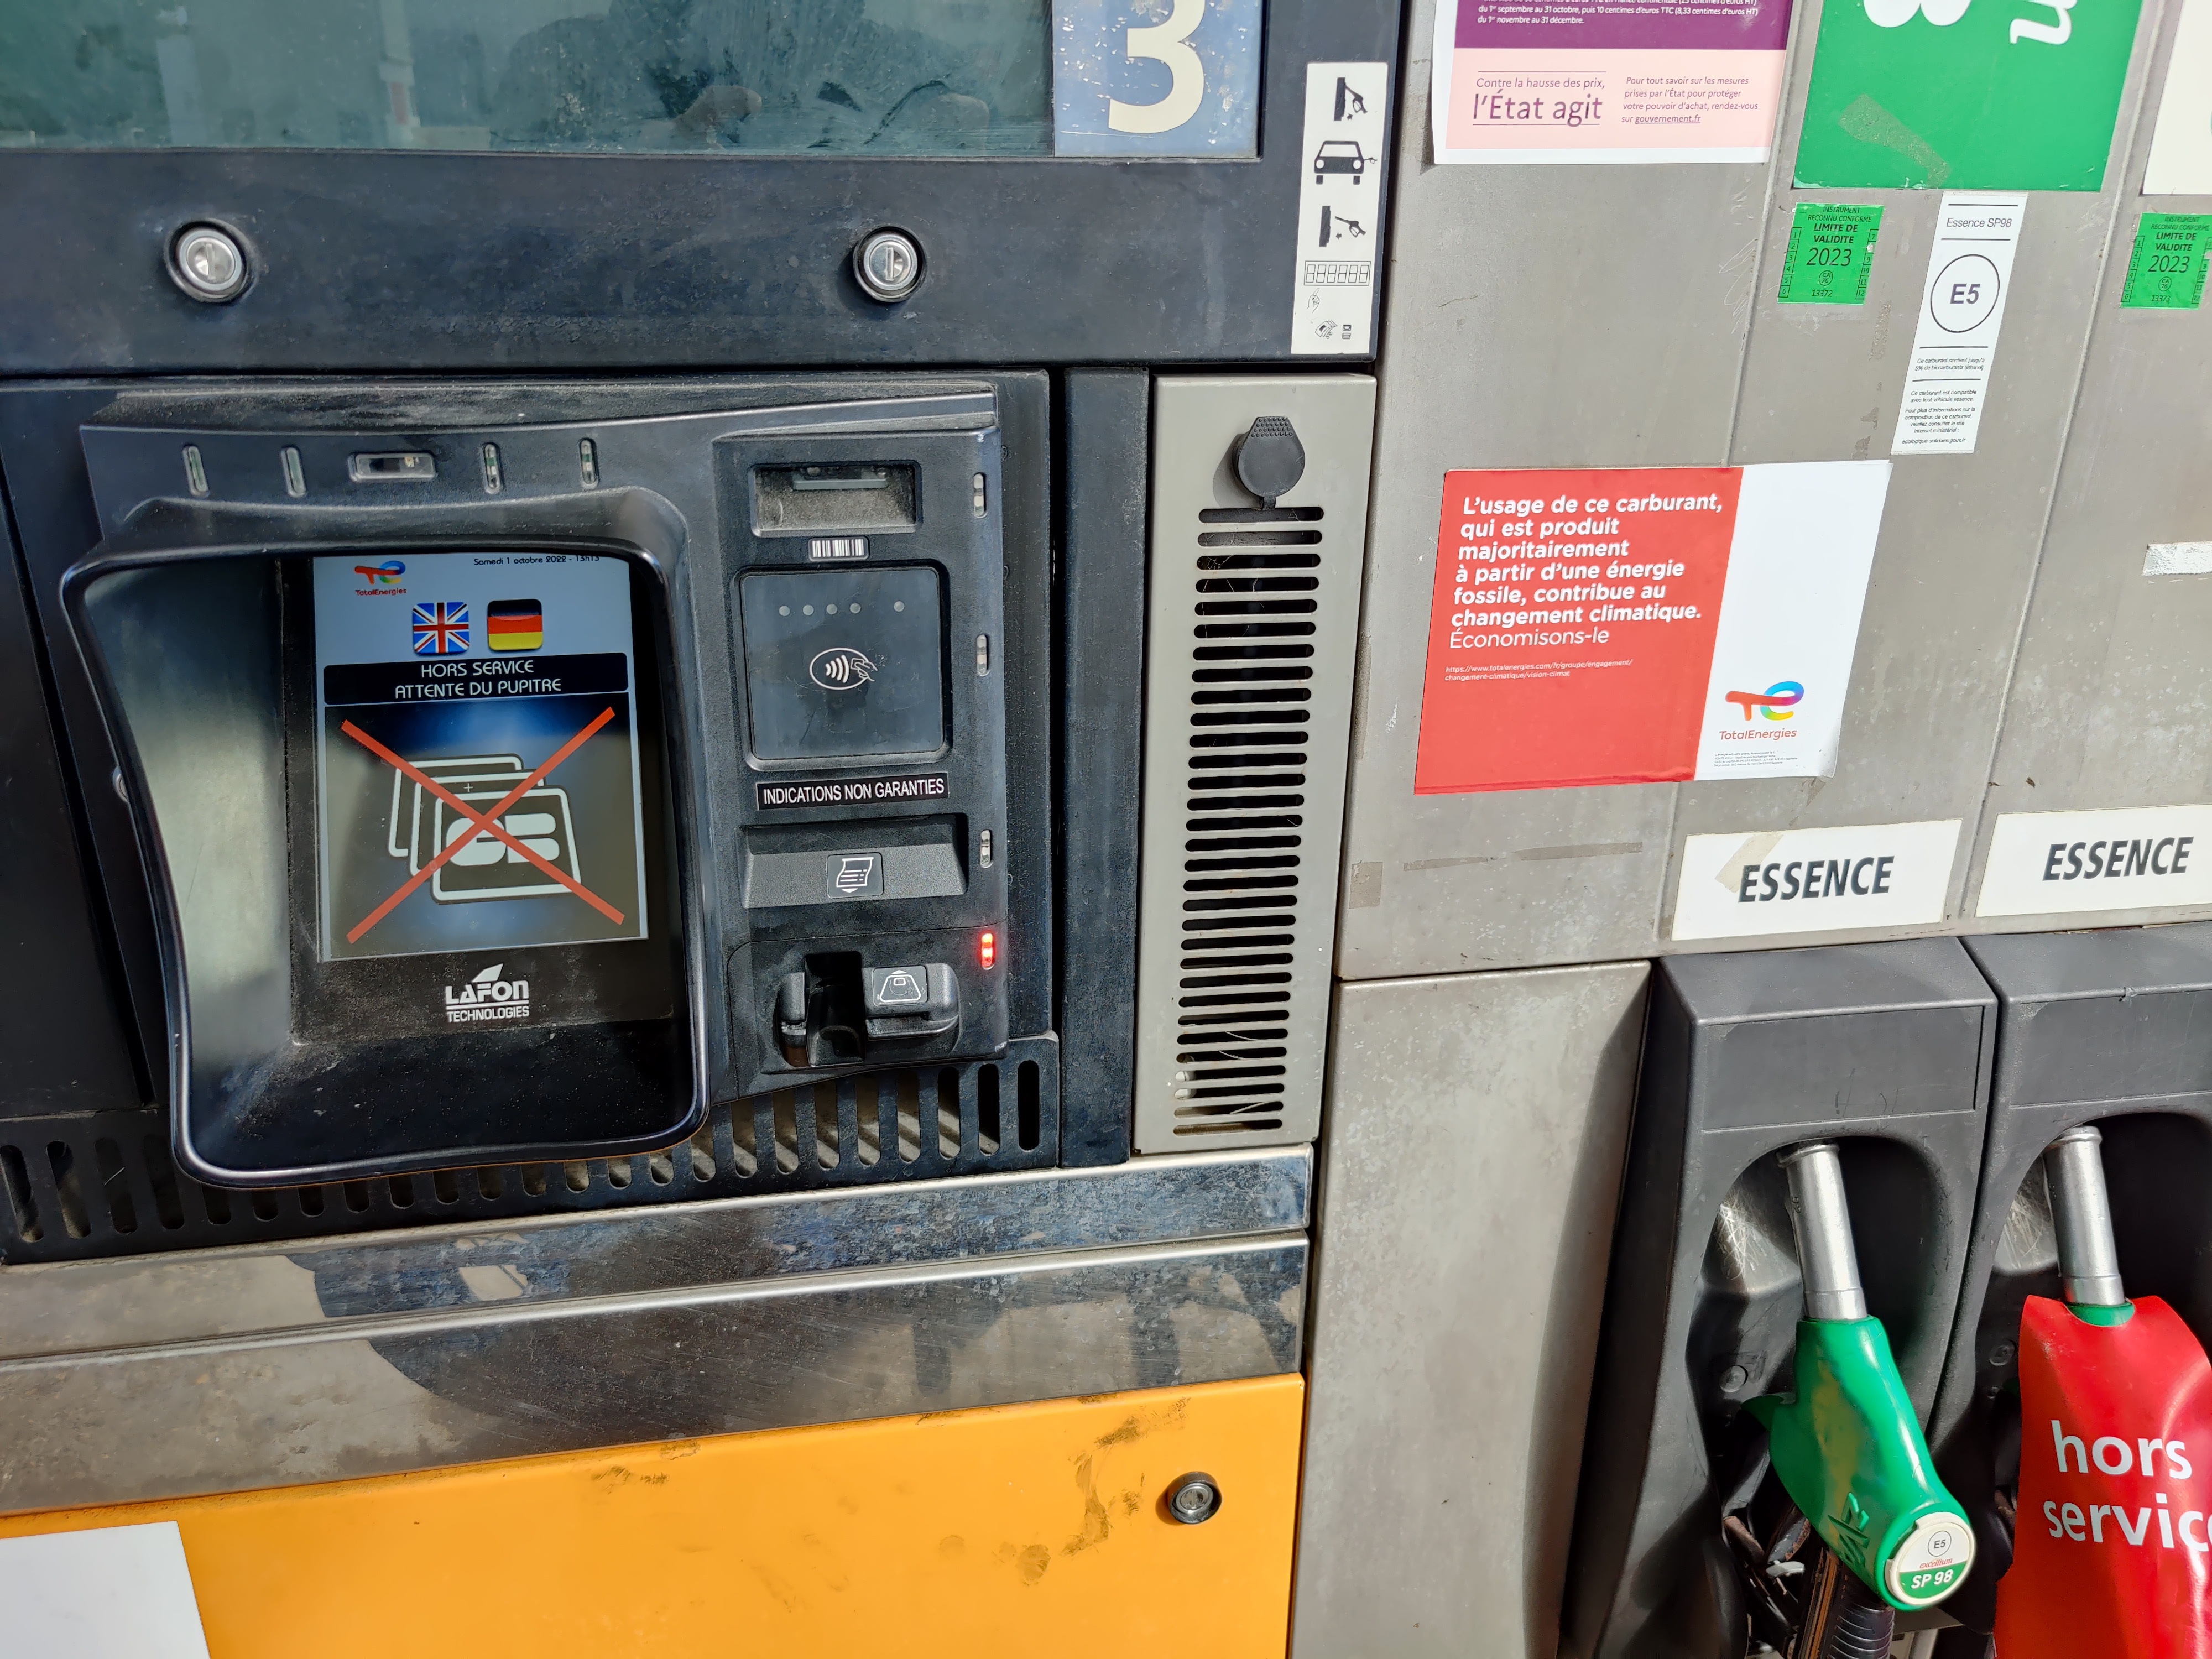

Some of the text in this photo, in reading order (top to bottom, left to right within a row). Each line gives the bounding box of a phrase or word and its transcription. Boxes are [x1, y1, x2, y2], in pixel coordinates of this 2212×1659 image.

[1498, 6, 1533, 14] septembre
[1553, 6, 1580, 14] octobre,
[1582, 6, 1595, 14] puis
[1675, 7, 1691, 15] (8,33
[1109, 0, 1206, 133] 3
[1477, 77, 1605, 90] Contre la hausse des prix,
[1626, 76, 1645, 85] Pour
[1666, 76, 1688, 85] savoir
[1704, 76, 1715, 85] les
[1624, 90, 1647, 99] prises
[1708, 89, 1741, 99] protéger
[1553, 93, 1602, 127] agit
[1646, 102, 1676, 112] pouvoir
[1635, 114, 1701, 124] gouvernement.fr
[1813, 223, 1858, 232] LIMITE DE
[1946, 217, 2012, 228] Essence SP98
[1814, 235, 1854, 243] VALIDITE
[1806, 248, 1852, 266] 2023
[2148, 255, 2190, 273] 2023
[1950, 283, 1980, 304] E5
[1551, 494, 1577, 514] de
[1584, 498, 1609, 513] ce
[1615, 493, 1722, 513] carburant,
[1460, 517, 1620, 540] qui est produit
[1458, 539, 1630, 563] majoritairement
[1455, 564, 1468, 583] à
[1475, 563, 1535, 585] partir
[1606, 559, 1685, 581] énergie
[355, 588, 407, 596] TotalEnergies
[1454, 583, 1666, 606] fossile, contribue au
[1451, 603, 1702, 628] changement climatique.
[1449, 626, 1610, 649] Économisons-le
[421, 660, 534, 678] HORS SERVICE
[1446, 659, 1633, 673] https://www.totalenergies.com/fr/groupe/engagement/
[1444, 670, 1570, 681] changement-climatique/vision-climat
[395, 679, 561, 699] ATTENTE DU PUPITRE
[1719, 728, 1797, 740] TotalEnergies
[764, 778, 945, 804] INDICATIONS NON GARANTIES
[2042, 836, 2194, 881] ESSENCE
[1738, 855, 1895, 902] ESSENCE
[447, 1005, 530, 1022] TECHNOLOGIES
[2051, 1420, 2192, 1479] hors
[2043, 1493, 2212, 1552] servic
[1934, 1539, 1946, 1549] E5
[1919, 1558, 1953, 1569] excellium
[1911, 1569, 1954, 1589] SP 98
